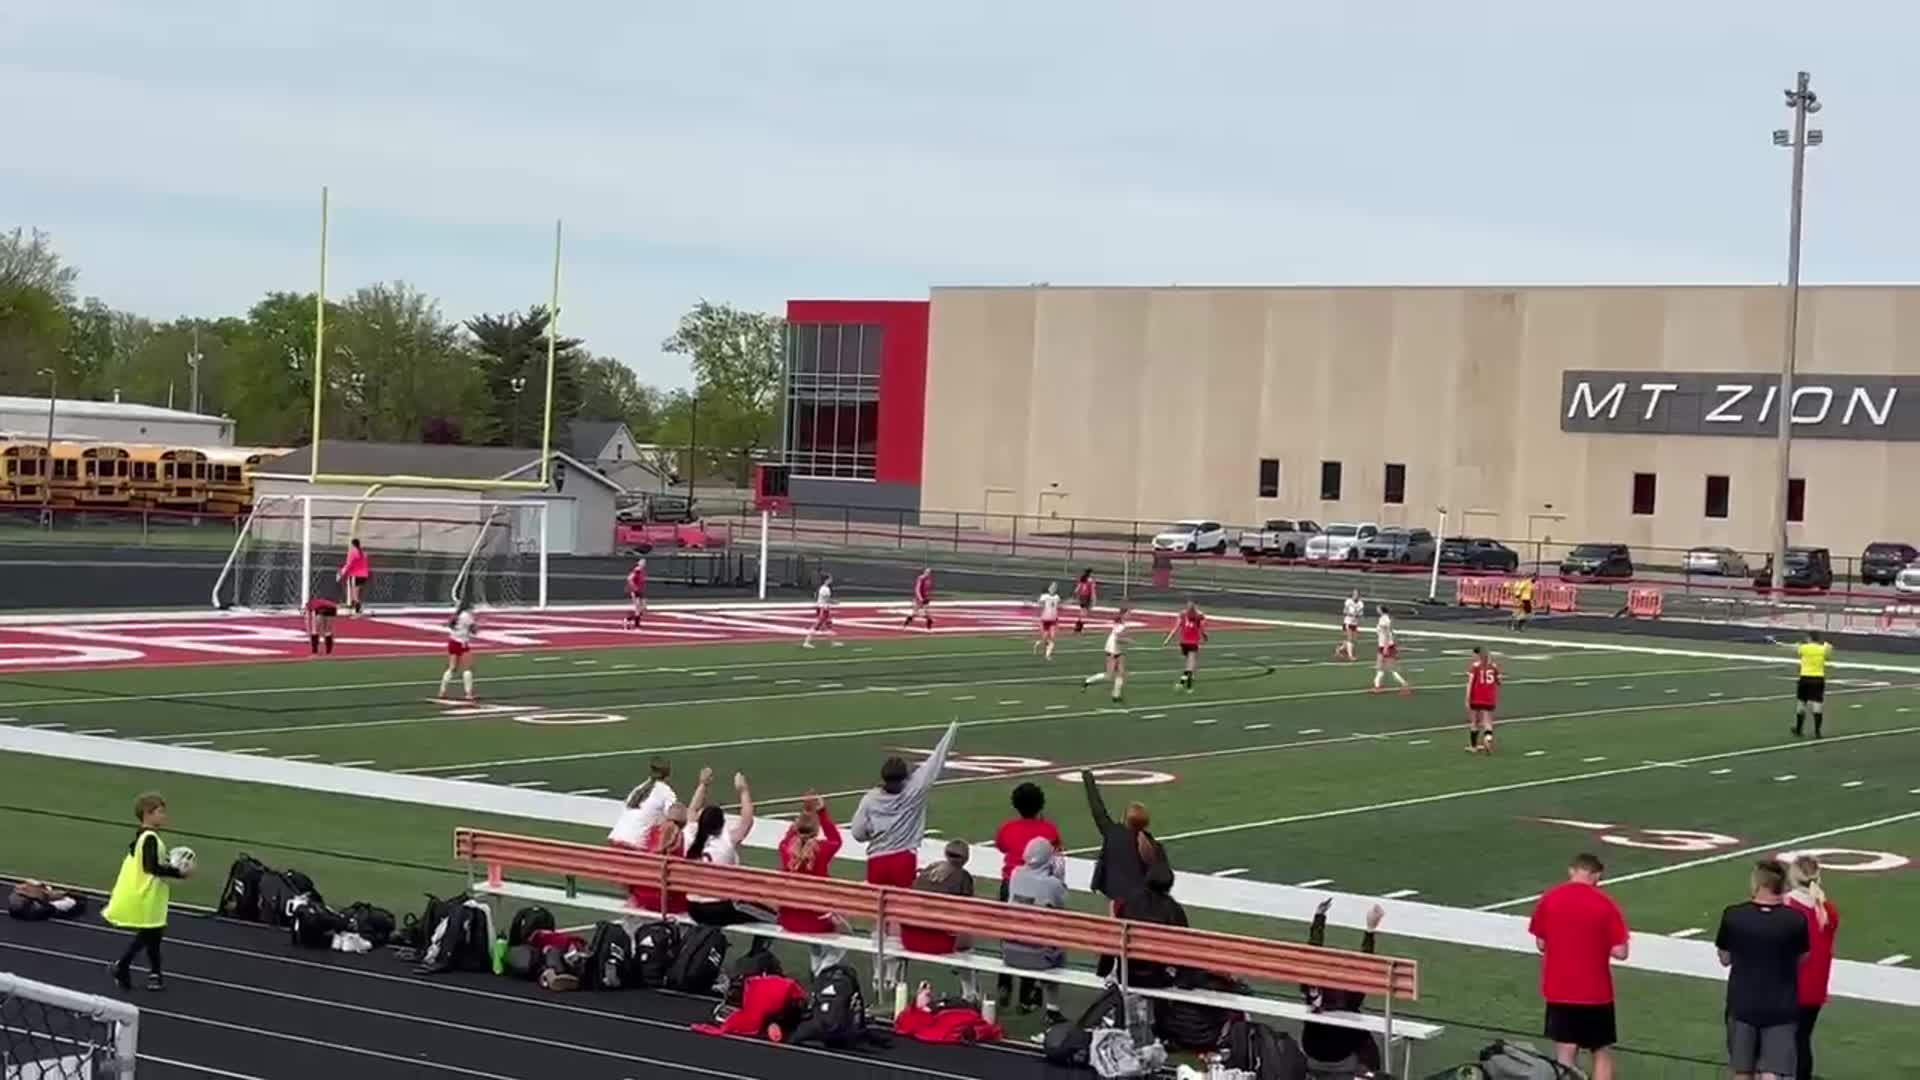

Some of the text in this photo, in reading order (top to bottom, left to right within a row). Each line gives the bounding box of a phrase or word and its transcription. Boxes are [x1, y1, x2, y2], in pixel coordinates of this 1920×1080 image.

[1567, 382, 1897, 426] MT ZION
[1480, 669, 1495, 685] 15
